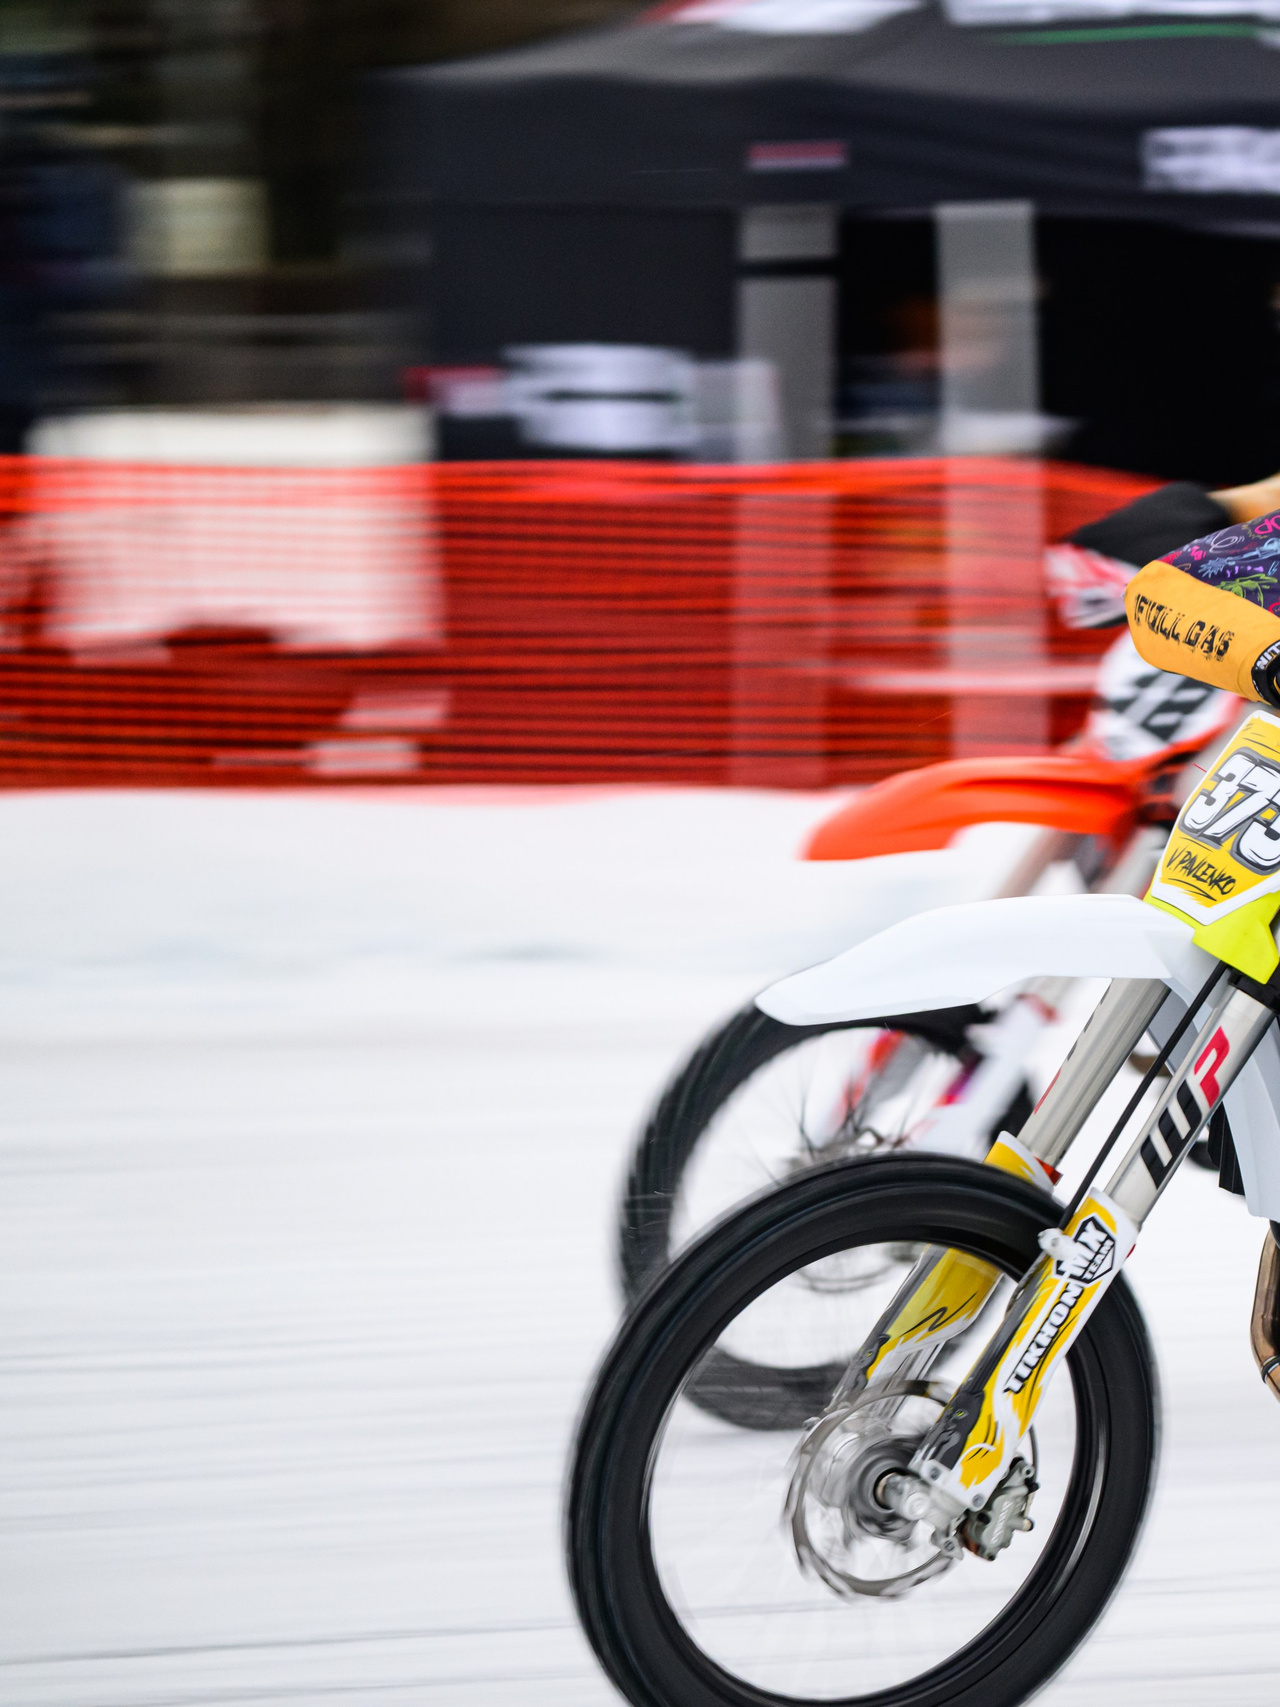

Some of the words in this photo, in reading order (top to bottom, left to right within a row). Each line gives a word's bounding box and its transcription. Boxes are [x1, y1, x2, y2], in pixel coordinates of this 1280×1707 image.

[1134, 593, 1186, 645] FULL
[1140, 1025, 1231, 1191] WP
[1082, 1238, 1115, 1281] TEAM
[1004, 1281, 1085, 1394] TIKHON
